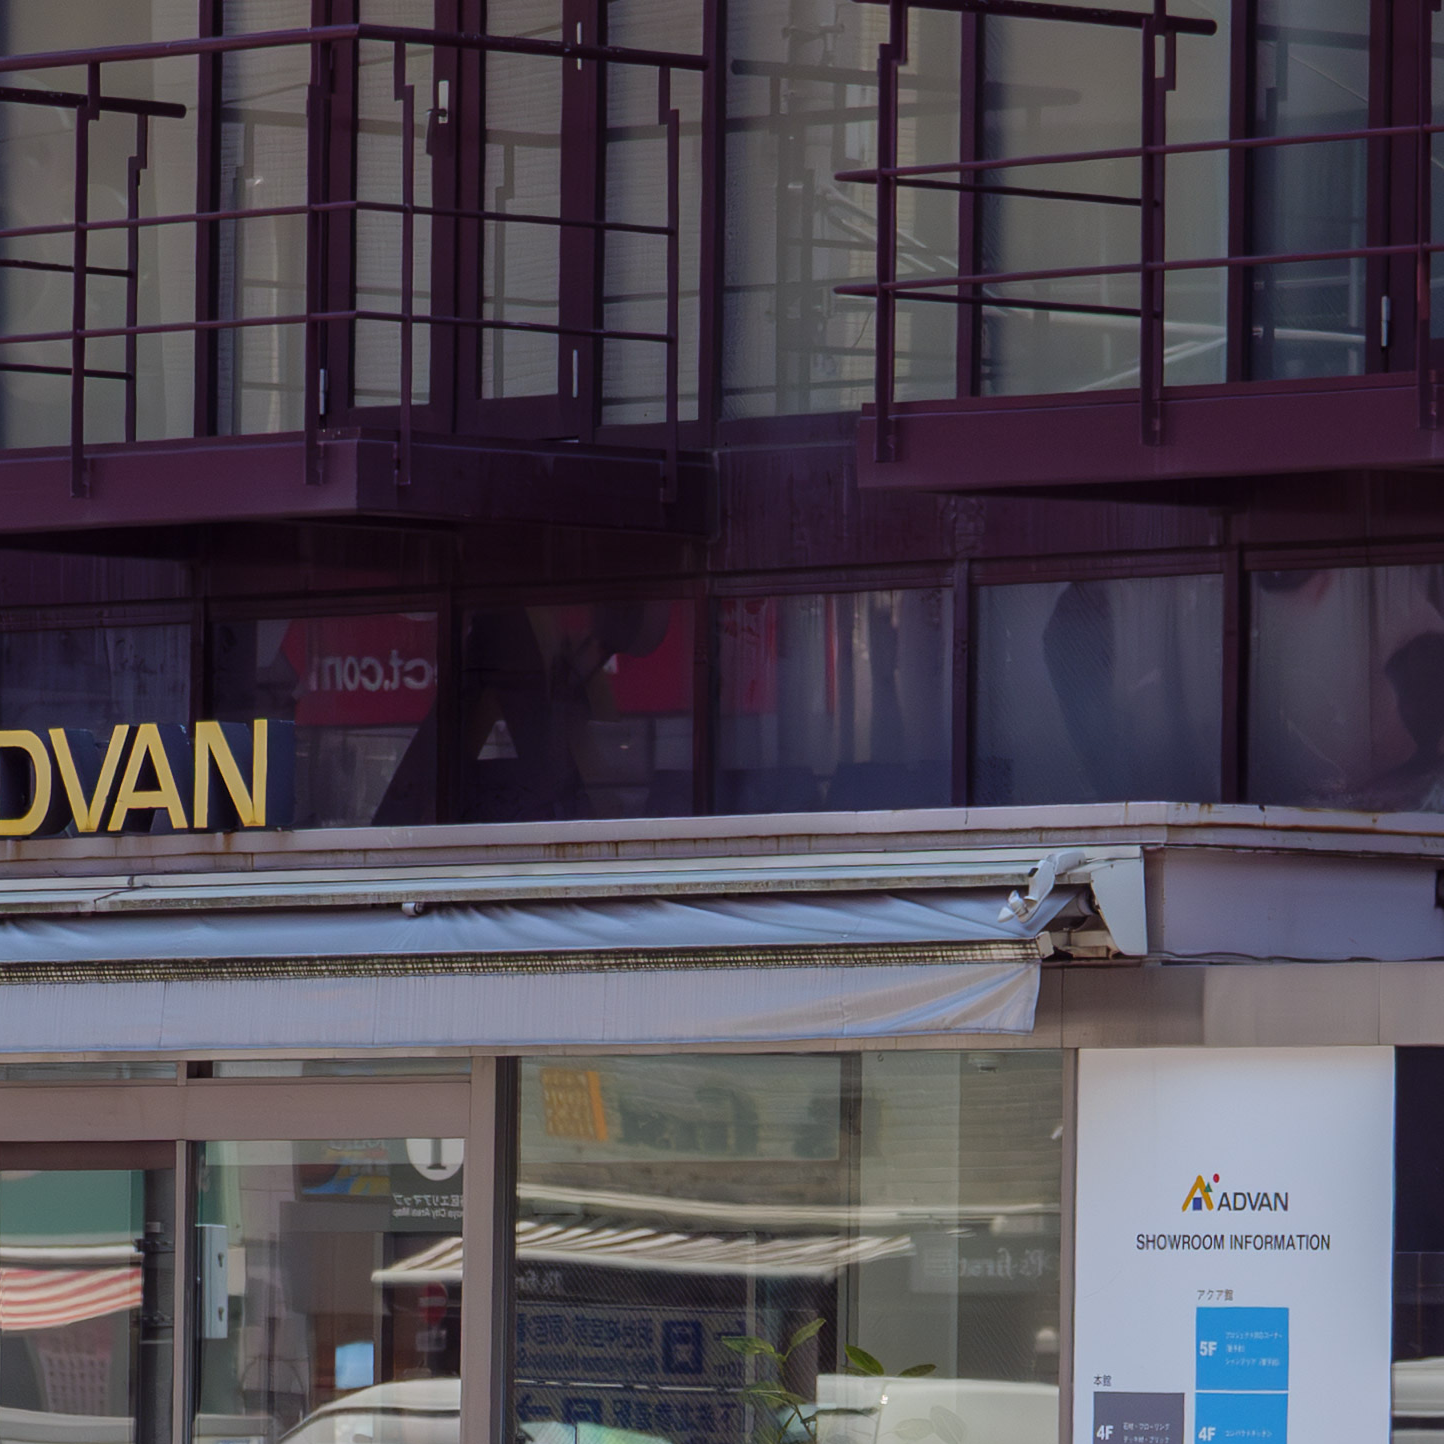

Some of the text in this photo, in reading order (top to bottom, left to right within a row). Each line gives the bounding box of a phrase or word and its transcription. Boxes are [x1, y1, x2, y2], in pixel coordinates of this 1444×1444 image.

[1217, 1191, 1289, 1211] ADVAN
[1136, 1233, 1331, 1251] SHOWROOM INFORMATION
[1197, 1289, 1234, 1301] アクア館
[1199, 1341, 1217, 1356] 5F
[1093, 1375, 1112, 1387] 本館
[1096, 1425, 1114, 1440] 4F
[1198, 1427, 1216, 1441] 4F
